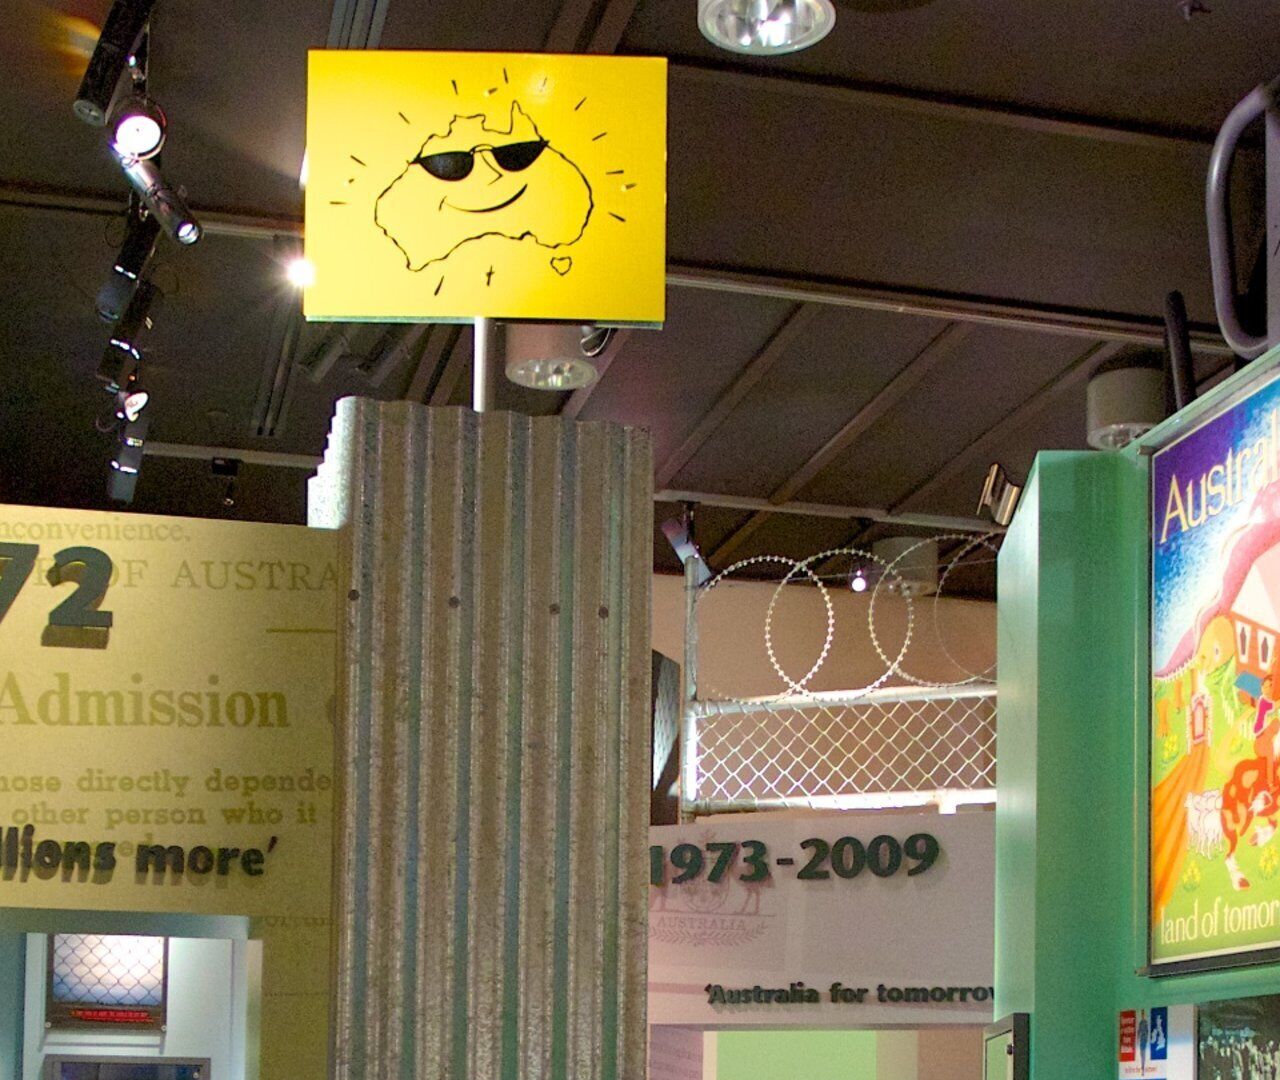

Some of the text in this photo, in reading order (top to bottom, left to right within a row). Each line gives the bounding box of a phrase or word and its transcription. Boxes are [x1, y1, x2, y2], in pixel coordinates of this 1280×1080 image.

[77, 769, 189, 798] directly
[11, 803, 88, 826] other
[106, 805, 206, 830] person
[222, 803, 283, 826] who
[295, 804, 316, 826] it
[650, 833, 941, 885] 1973-2009
[657, 917, 747, 933] AUSTRALIA
[1160, 900, 1198, 945] land
[1201, 896, 1221, 937] of
[829, 982, 869, 1004] for
